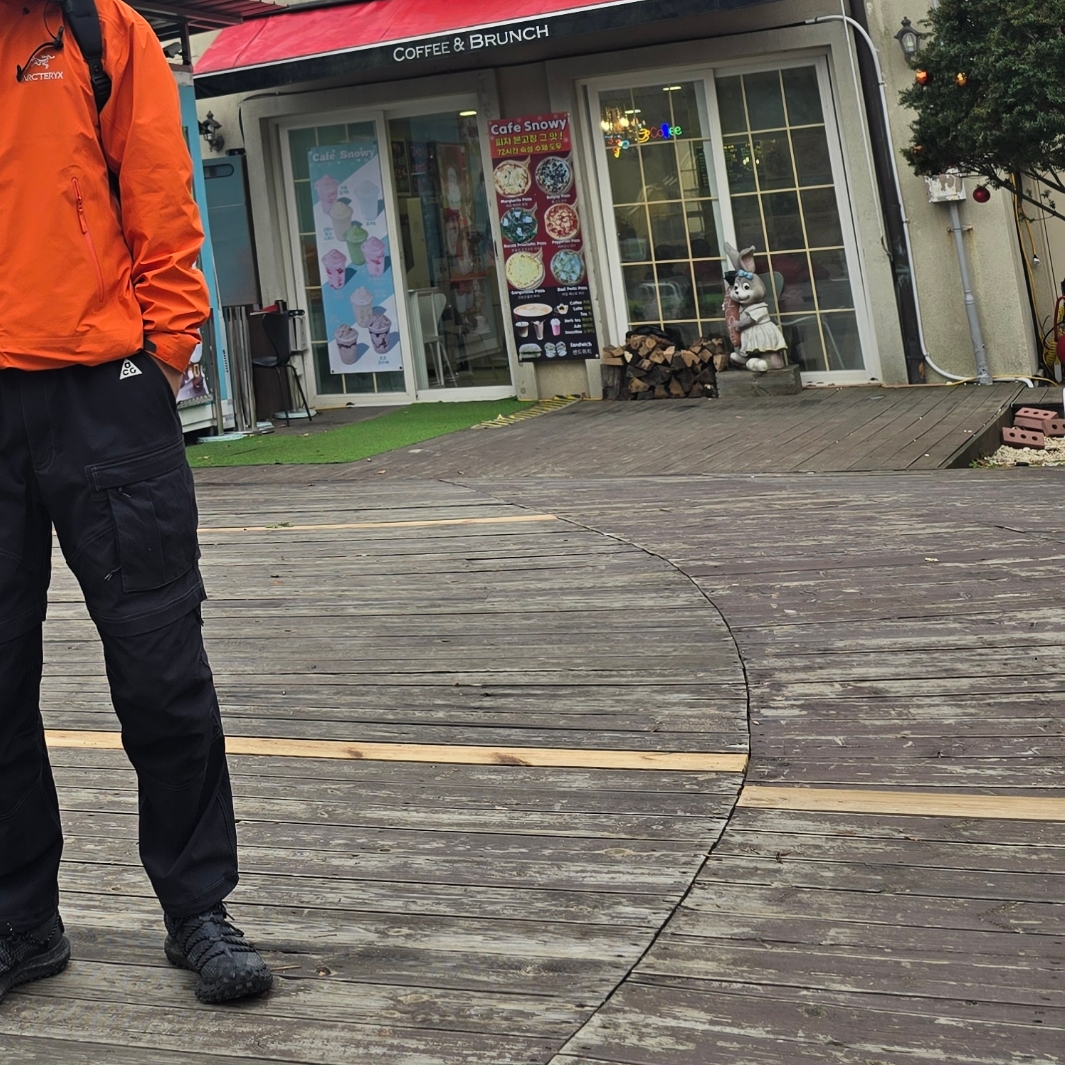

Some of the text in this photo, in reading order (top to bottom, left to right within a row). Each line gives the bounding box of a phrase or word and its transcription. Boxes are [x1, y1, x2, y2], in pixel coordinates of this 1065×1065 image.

[393, 24, 549, 62] COFFEE & BRUNCH
[491, 119, 567, 135] Cafe Snowy
[495, 137, 511, 147] 피자
[539, 133, 547, 142] 그
[340, 149, 375, 160] Snowy
